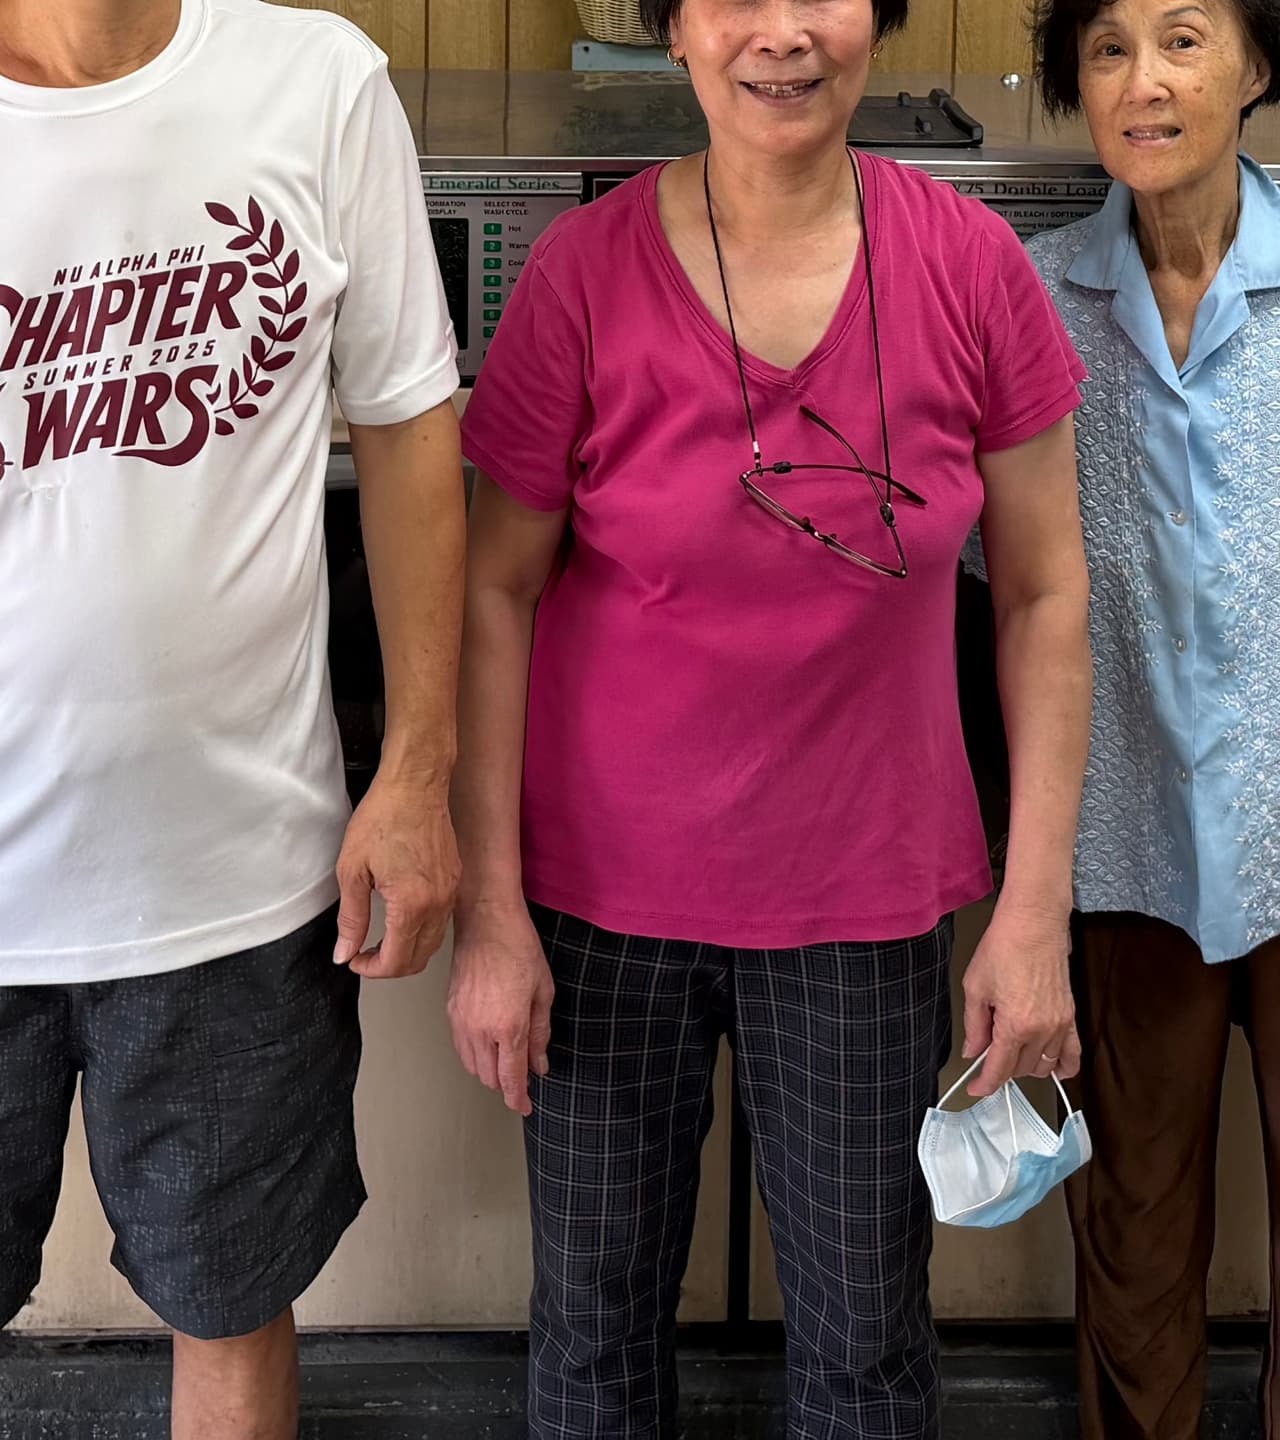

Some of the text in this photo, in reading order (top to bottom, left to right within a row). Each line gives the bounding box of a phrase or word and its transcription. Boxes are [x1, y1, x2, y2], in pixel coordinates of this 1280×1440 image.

[54, 245, 205, 287] NU ALPHA PHI
[23, 340, 217, 390] SUMMER 2025
[21, 364, 219, 470] WARS
